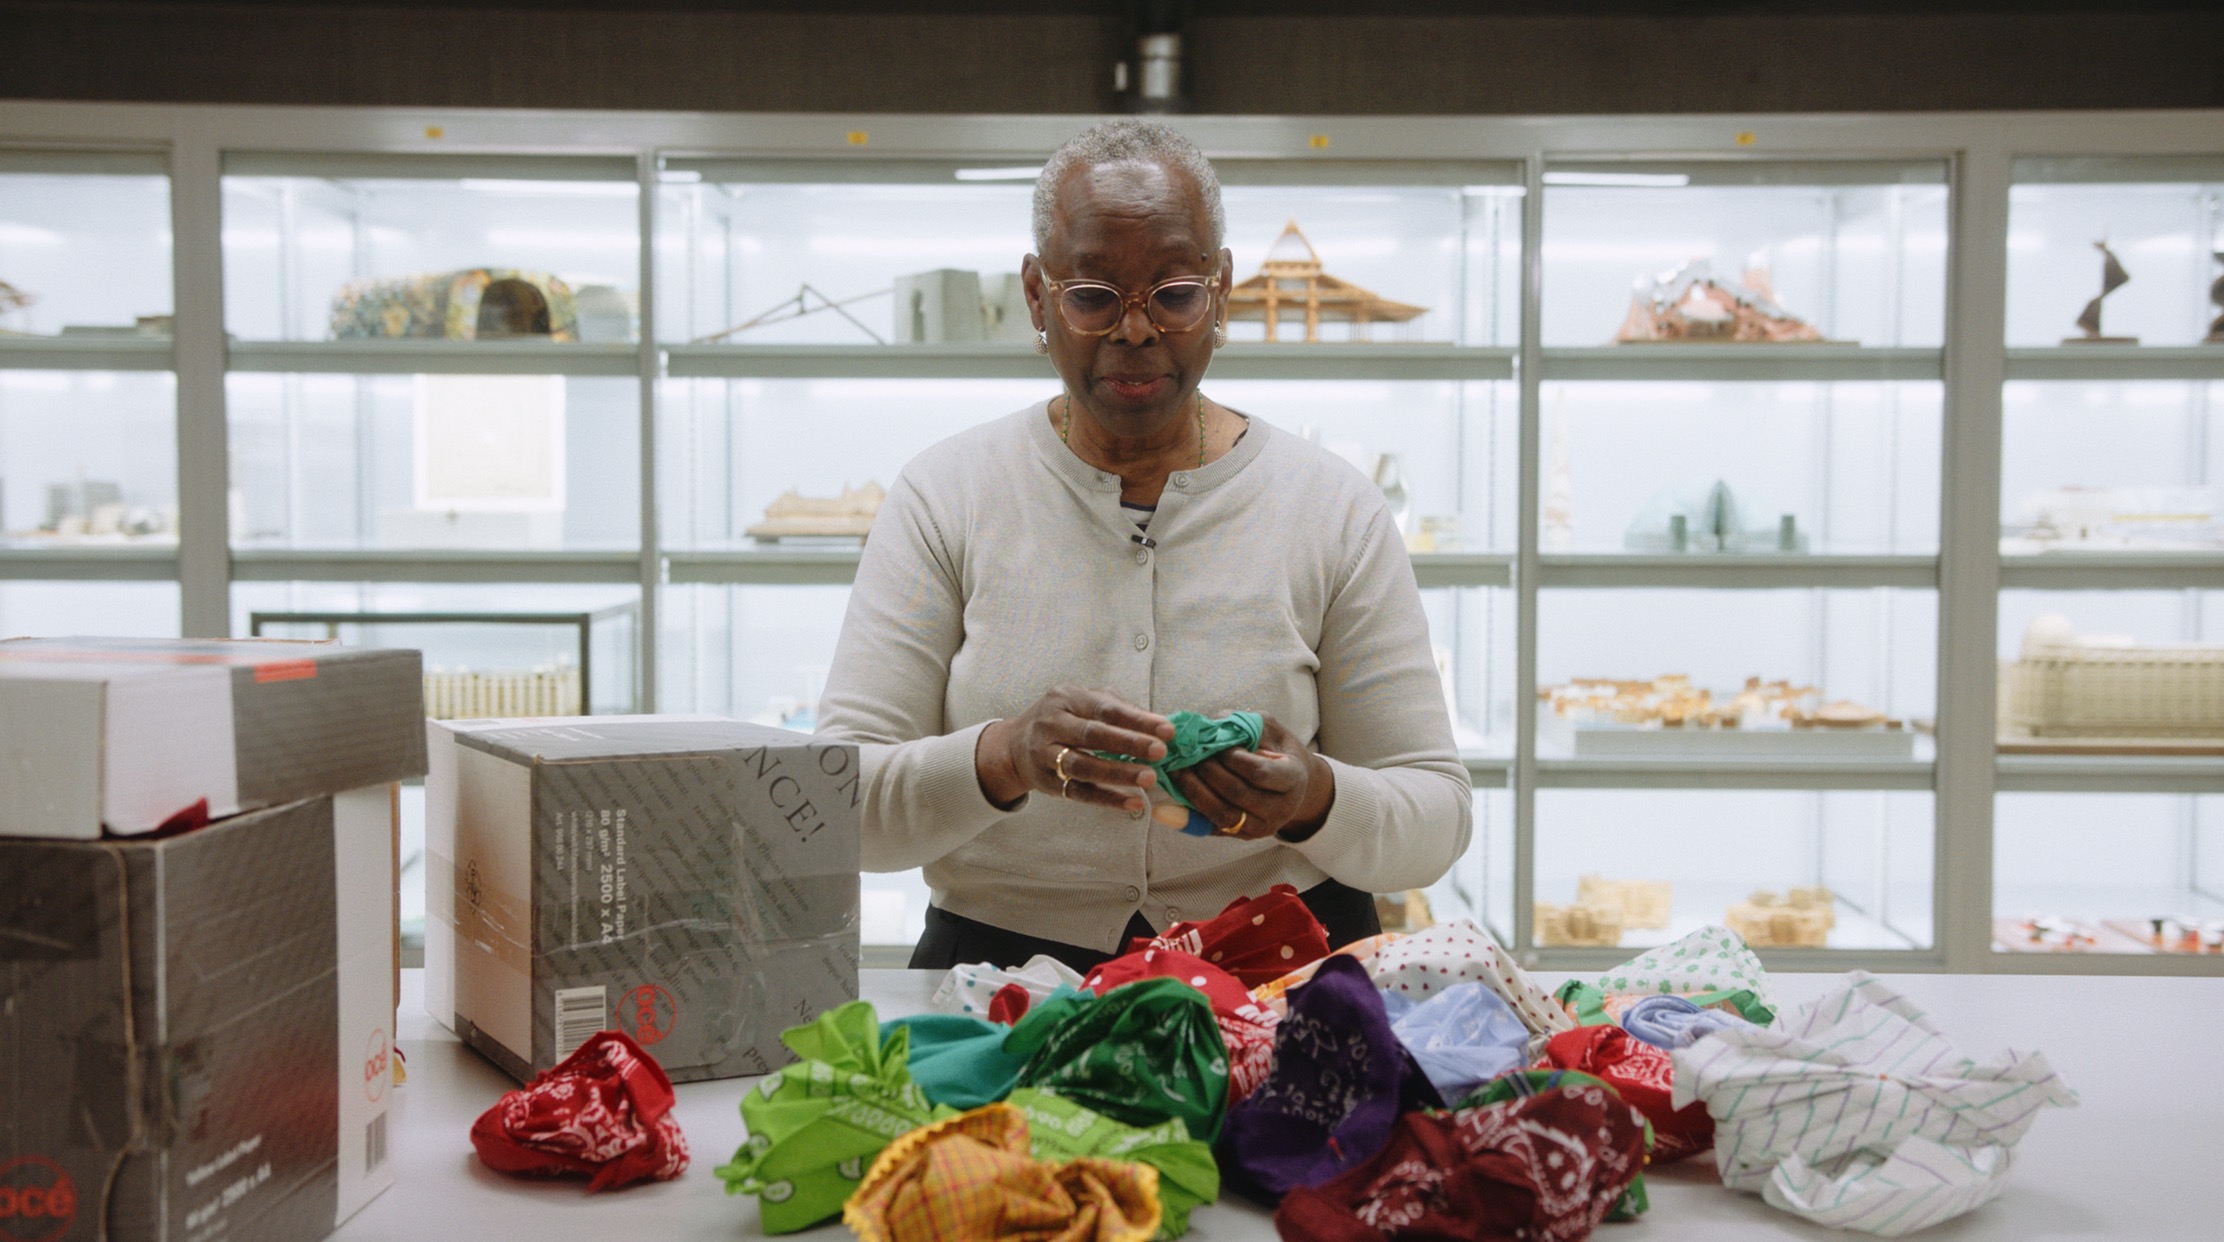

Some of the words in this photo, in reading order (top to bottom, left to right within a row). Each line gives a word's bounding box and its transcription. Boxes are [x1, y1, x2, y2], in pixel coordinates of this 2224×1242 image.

[735, 745, 826, 843] NCE!
[806, 743, 860, 809] ON
[600, 809, 611, 826] 80
[615, 808, 627, 865] Standard
[600, 863, 613, 904] 2500
[615, 868, 627, 902] Label
[601, 908, 610, 918] x
[614, 904, 627, 941] Paper
[600, 922, 613, 945] A4
[636, 986, 663, 1046] océ
